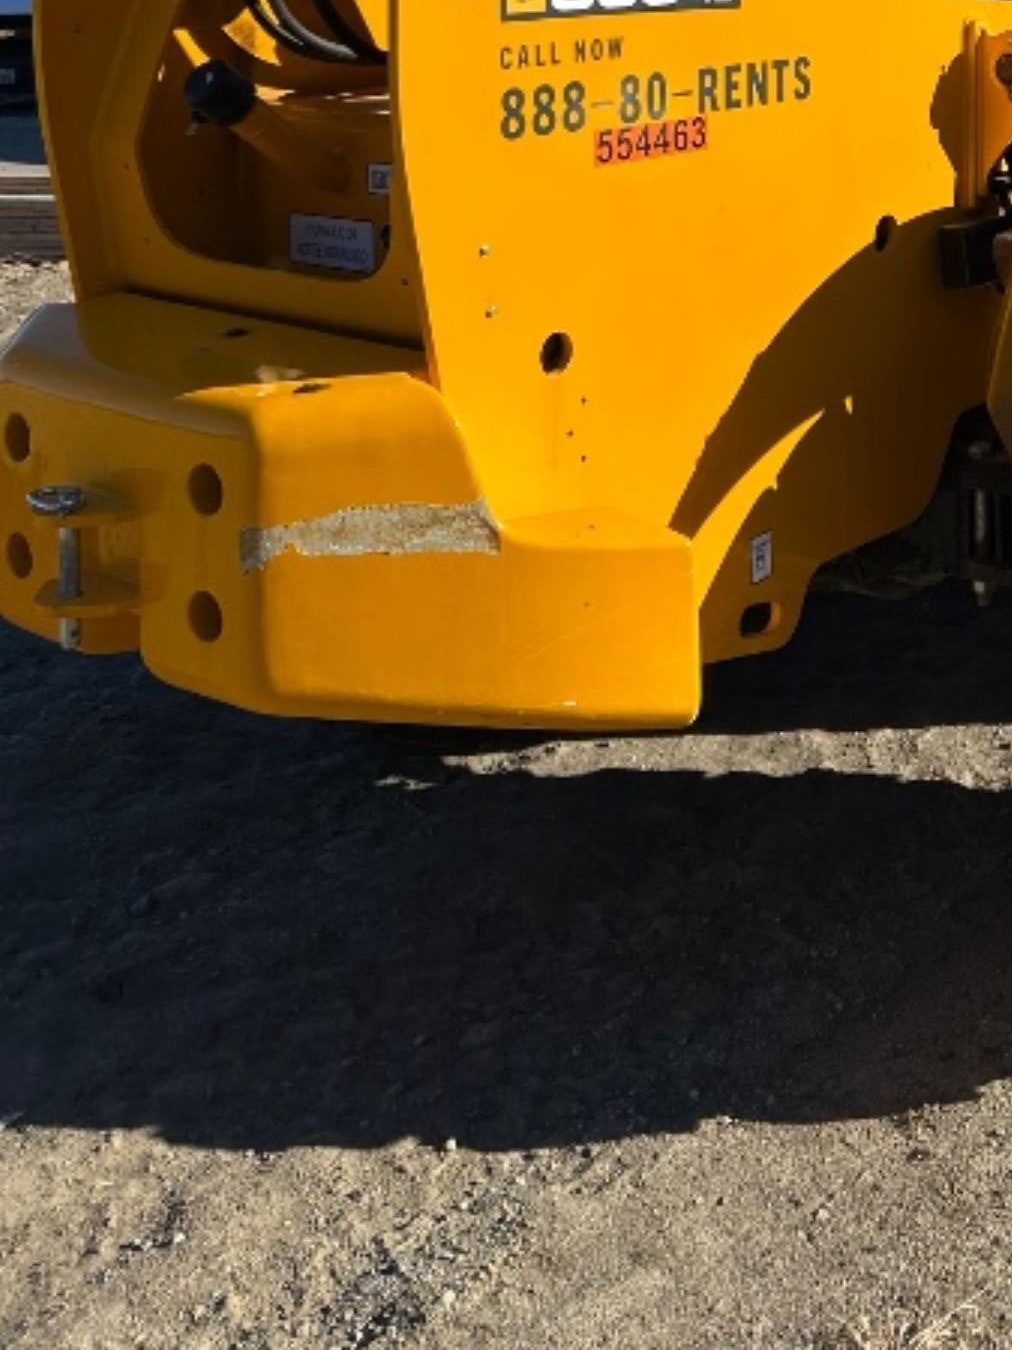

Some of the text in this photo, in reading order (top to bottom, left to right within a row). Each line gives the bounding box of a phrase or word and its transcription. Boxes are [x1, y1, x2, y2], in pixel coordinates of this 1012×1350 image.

[500, 36, 625, 70] CALL NOW
[500, 56, 812, 141] 888-80-RENTS
[596, 116, 707, 164] 554463
